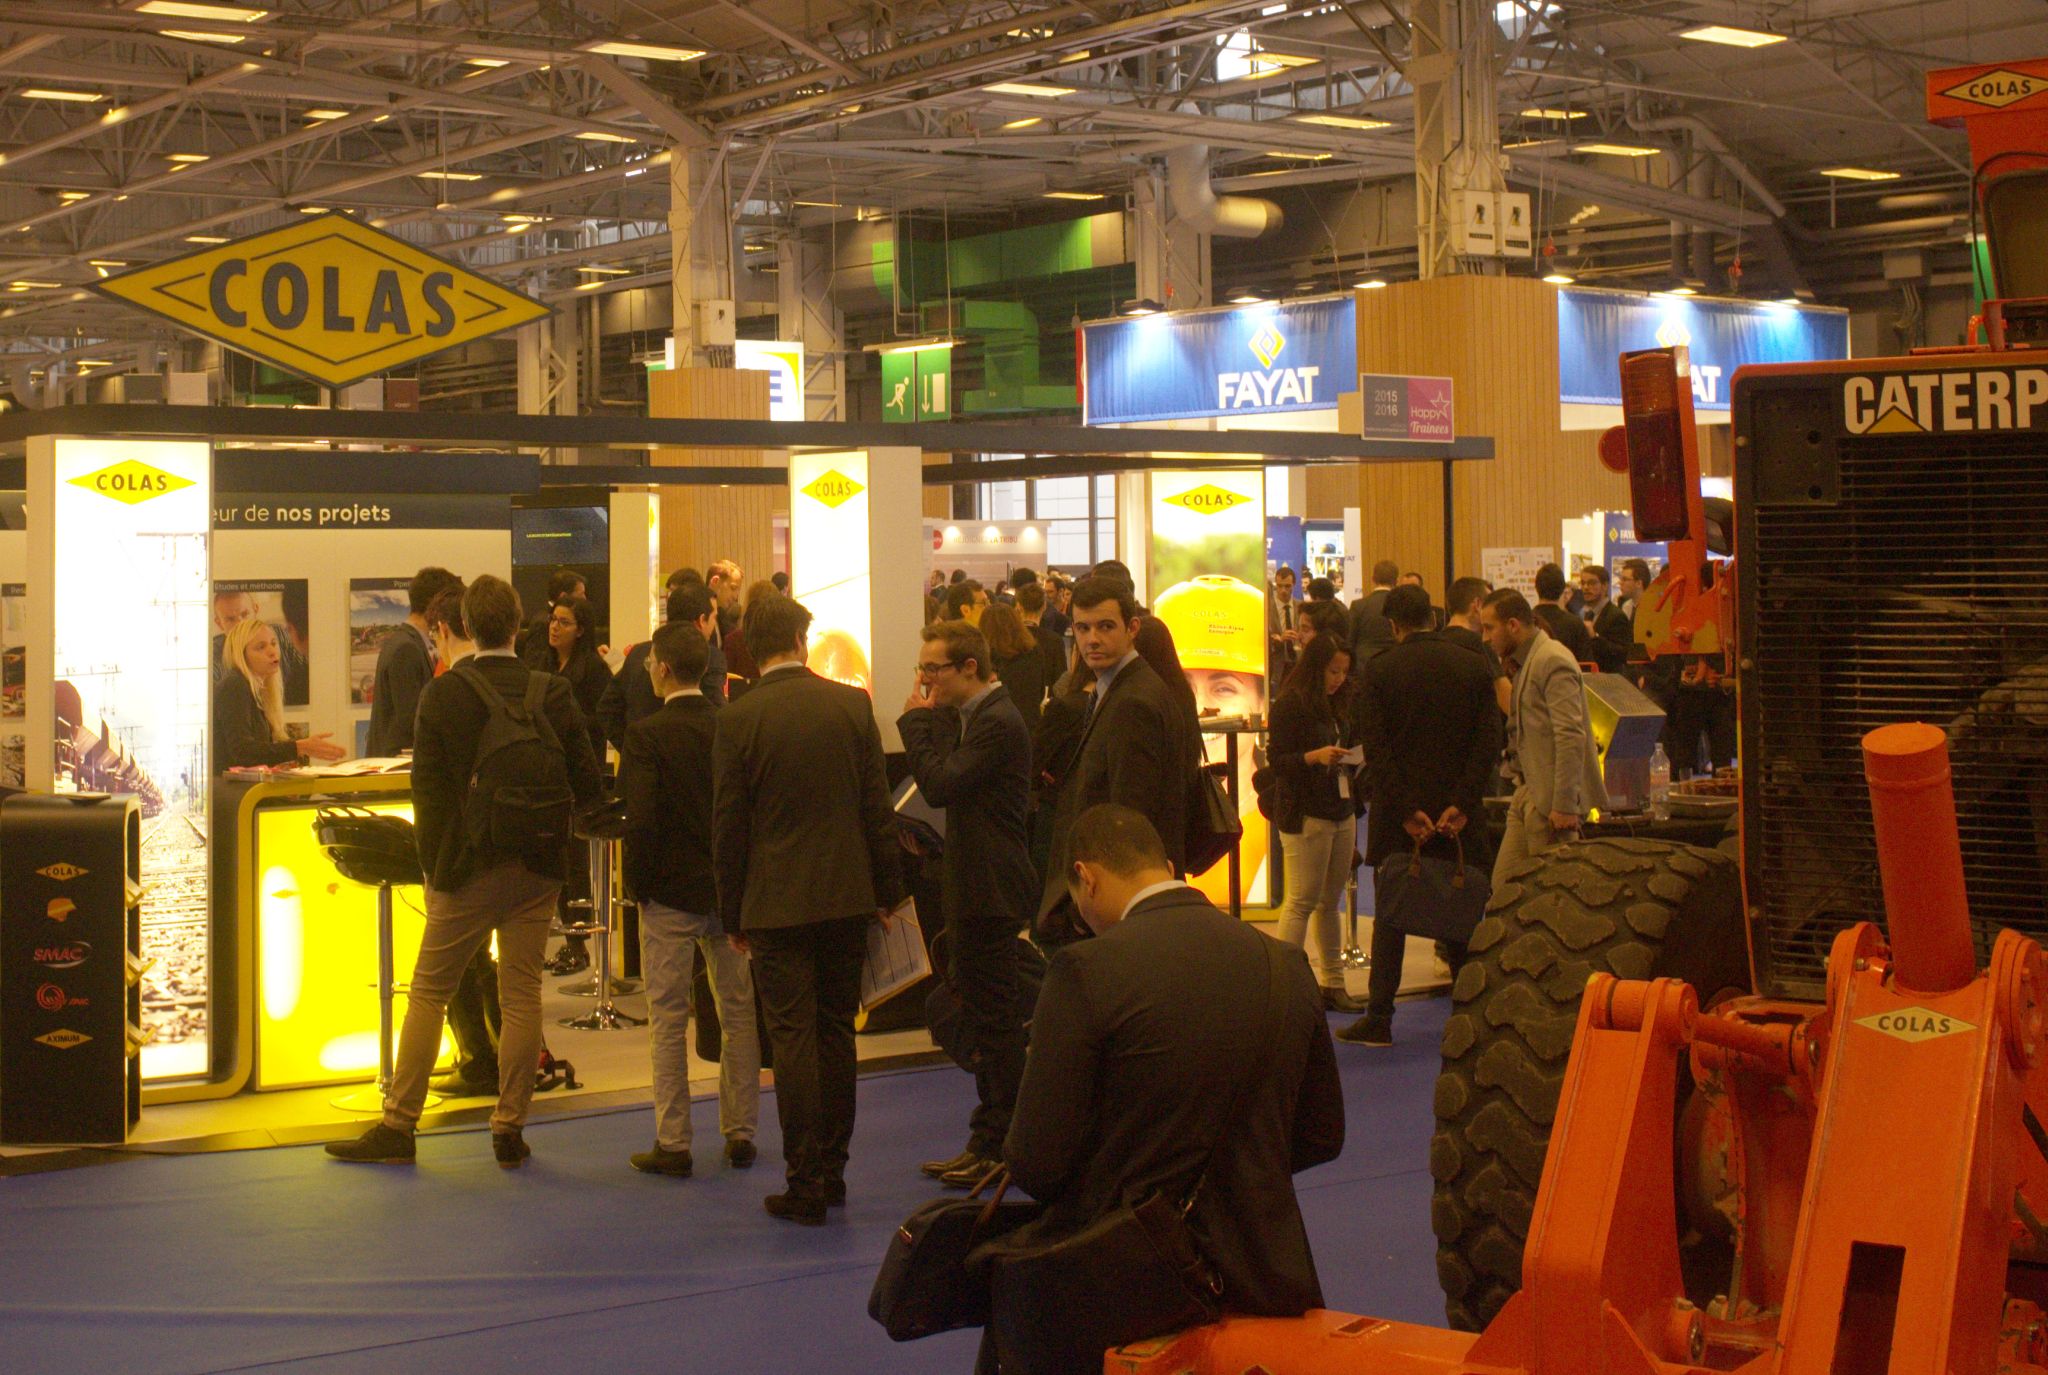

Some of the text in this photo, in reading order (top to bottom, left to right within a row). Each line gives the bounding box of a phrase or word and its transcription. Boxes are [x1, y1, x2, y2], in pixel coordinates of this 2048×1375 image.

[1968, 80, 2032, 98] COLAS
[209, 258, 456, 337] COLAS
[1218, 366, 1320, 409] FAYAT
[1375, 390, 1398, 402] 2015
[1844, 369, 2048, 434] CATERP
[1375, 404, 1398, 416] 2016
[1410, 406, 1441, 419] Happy
[1410, 421, 1449, 434] Trainees
[96, 474, 168, 491] COLAS
[815, 481, 851, 497] COLAS
[1182, 494, 1234, 506] COLAS
[244, 504, 270, 522] de
[276, 507, 312, 522] nos
[319, 503, 391, 526] projets
[45, 866, 80, 877] COLAS
[34, 947, 83, 961] SMAC
[1878, 1015, 1951, 1034] COLAS
[46, 1033, 80, 1043] AXIMUM
